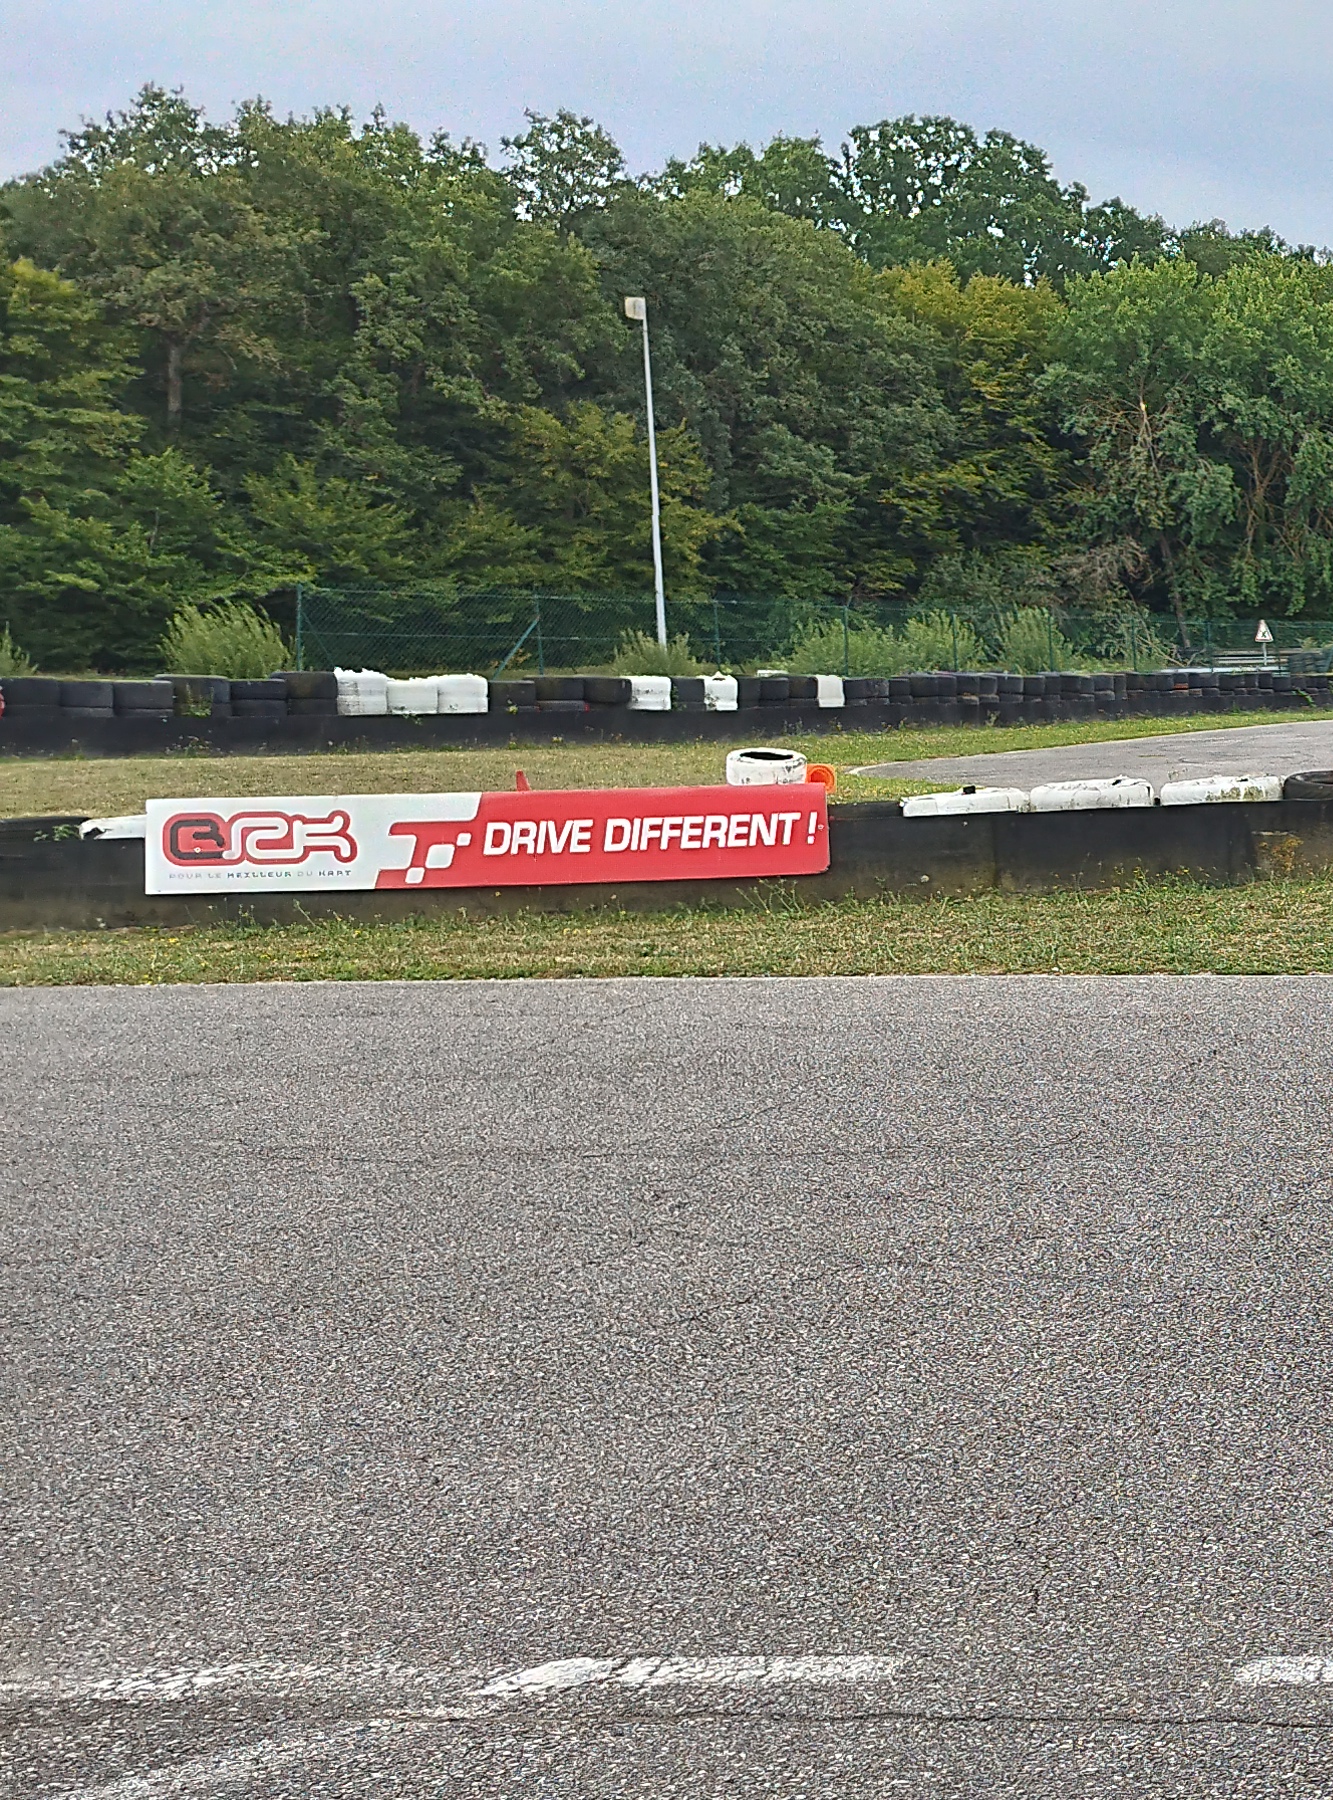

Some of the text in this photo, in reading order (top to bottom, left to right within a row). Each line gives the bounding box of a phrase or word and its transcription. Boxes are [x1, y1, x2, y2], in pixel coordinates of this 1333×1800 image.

[484, 818, 594, 856] DRIVE
[603, 811, 802, 853] DIFFERENT
[168, 869, 353, 880] POUR LE MEILLEUR DU KART
